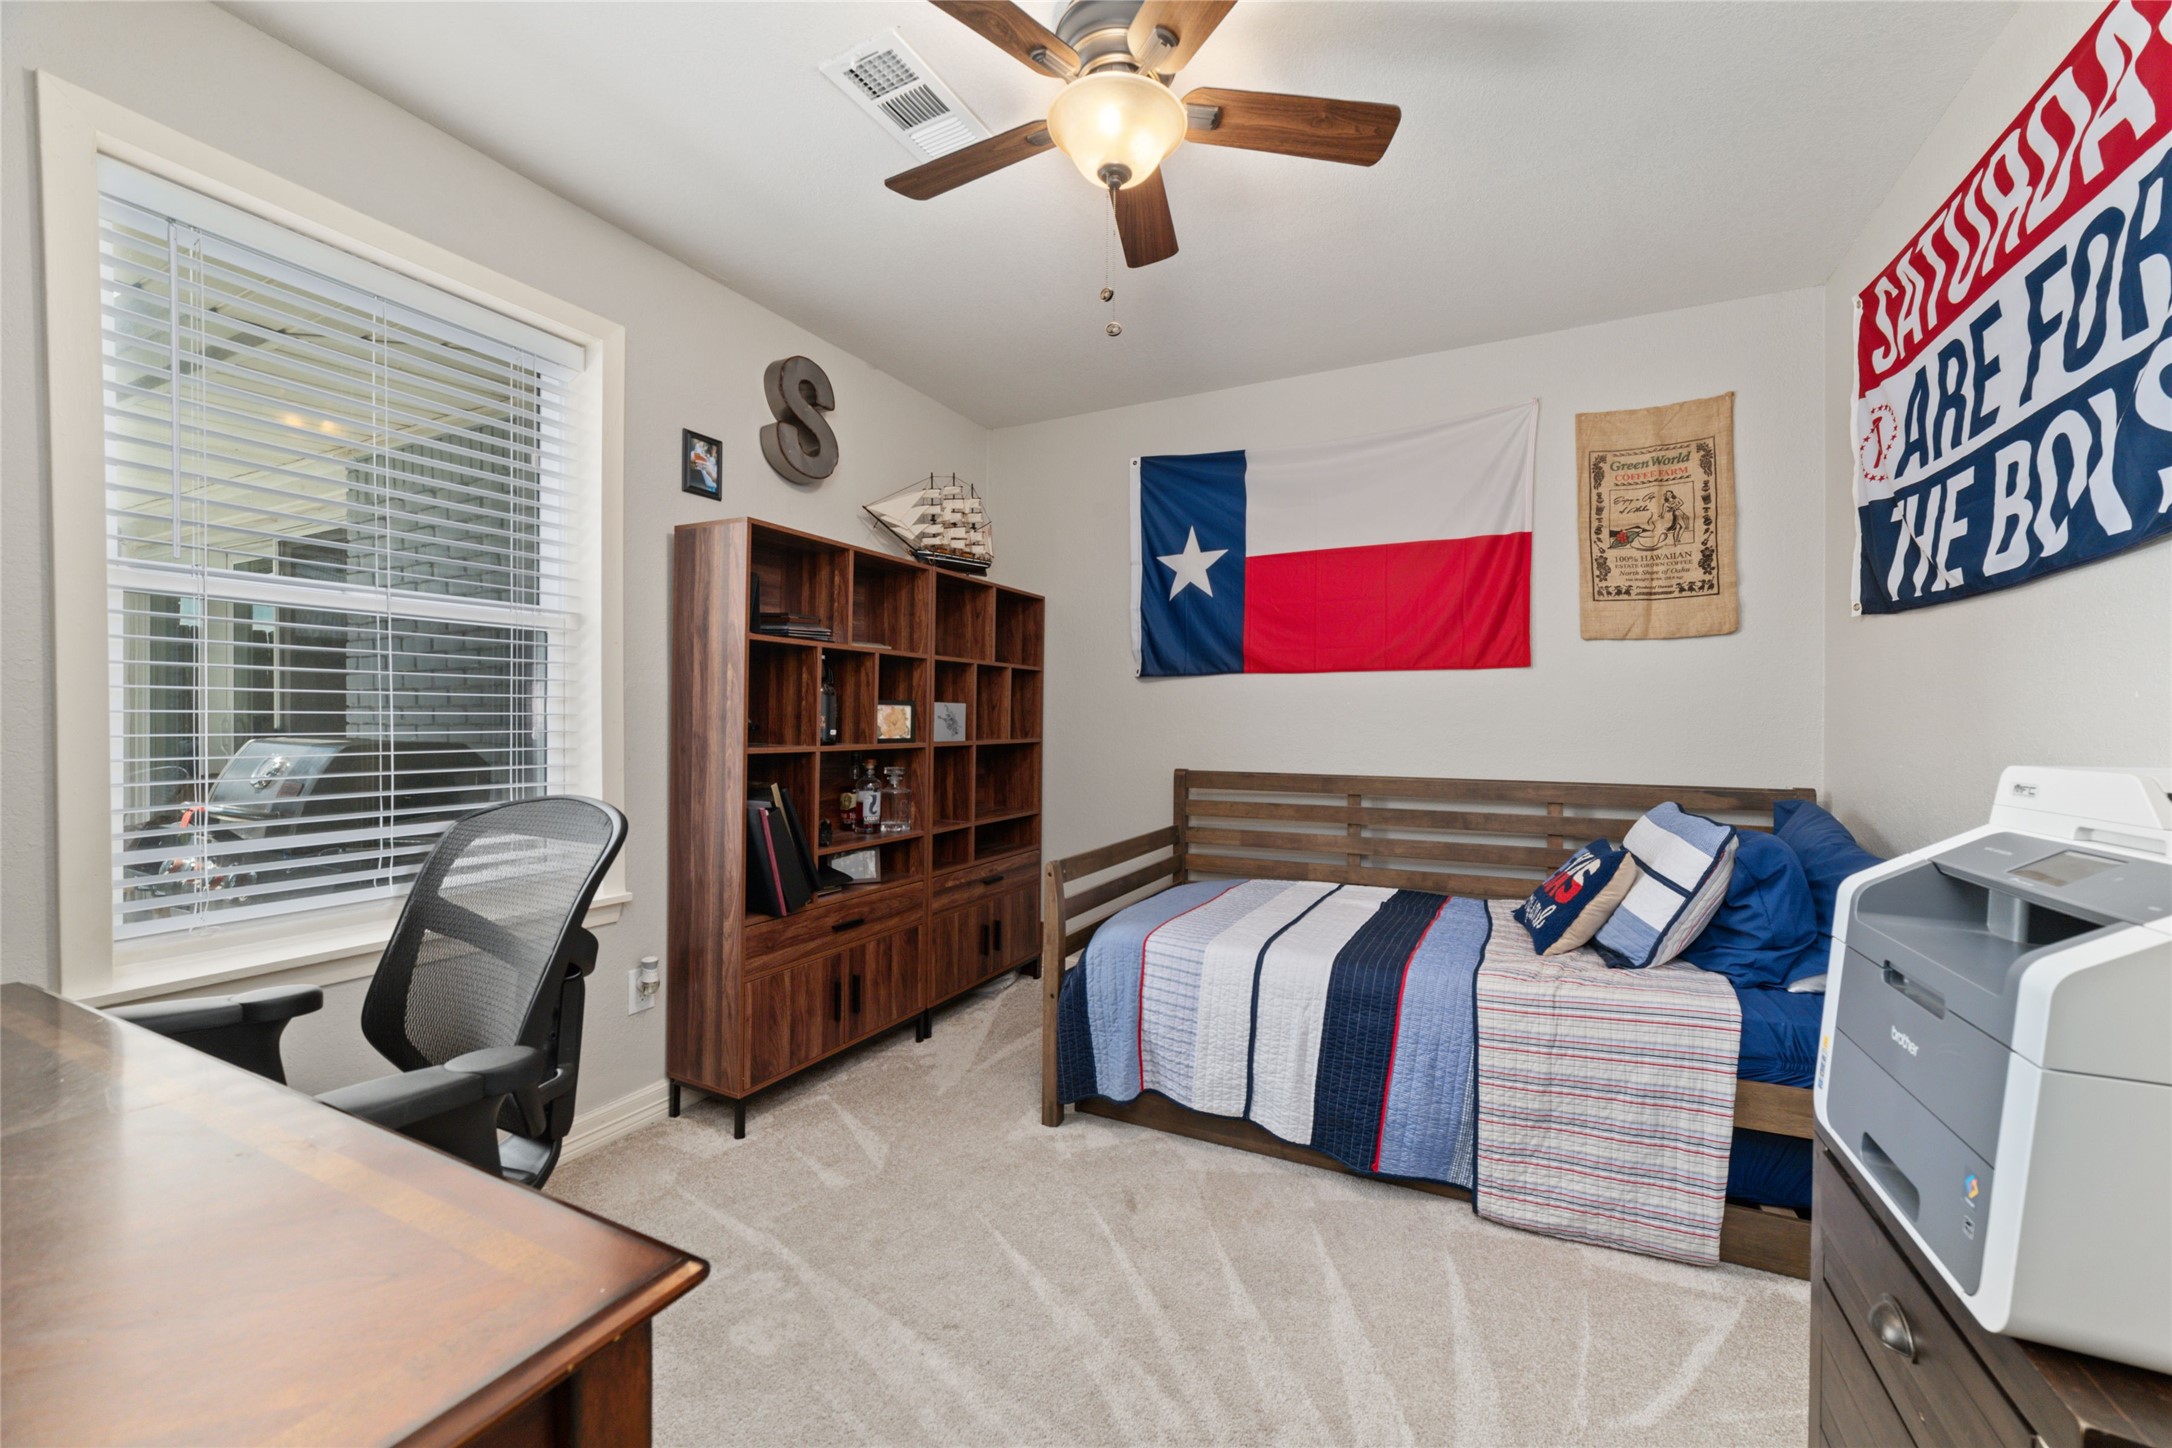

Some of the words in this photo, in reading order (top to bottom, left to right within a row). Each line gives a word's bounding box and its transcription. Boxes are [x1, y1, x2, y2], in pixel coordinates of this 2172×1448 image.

[1872, 0, 2172, 374] SATURDA
[1894, 300, 2006, 482] ARE
[2018, 150, 2172, 402] FOR
[760, 356, 839, 485] S
[1610, 460, 1650, 471] Green
[1650, 451, 1691, 467] World
[1615, 469, 1656, 482] COFFEE
[1658, 466, 1689, 477] FARM
[1889, 465, 1978, 601] THE
[1640, 551, 1692, 562] HAWAIIAN
[1661, 568, 1670, 576] of
[2014, 783, 2037, 796] MFC
[1891, 1024, 1919, 1057] brother
